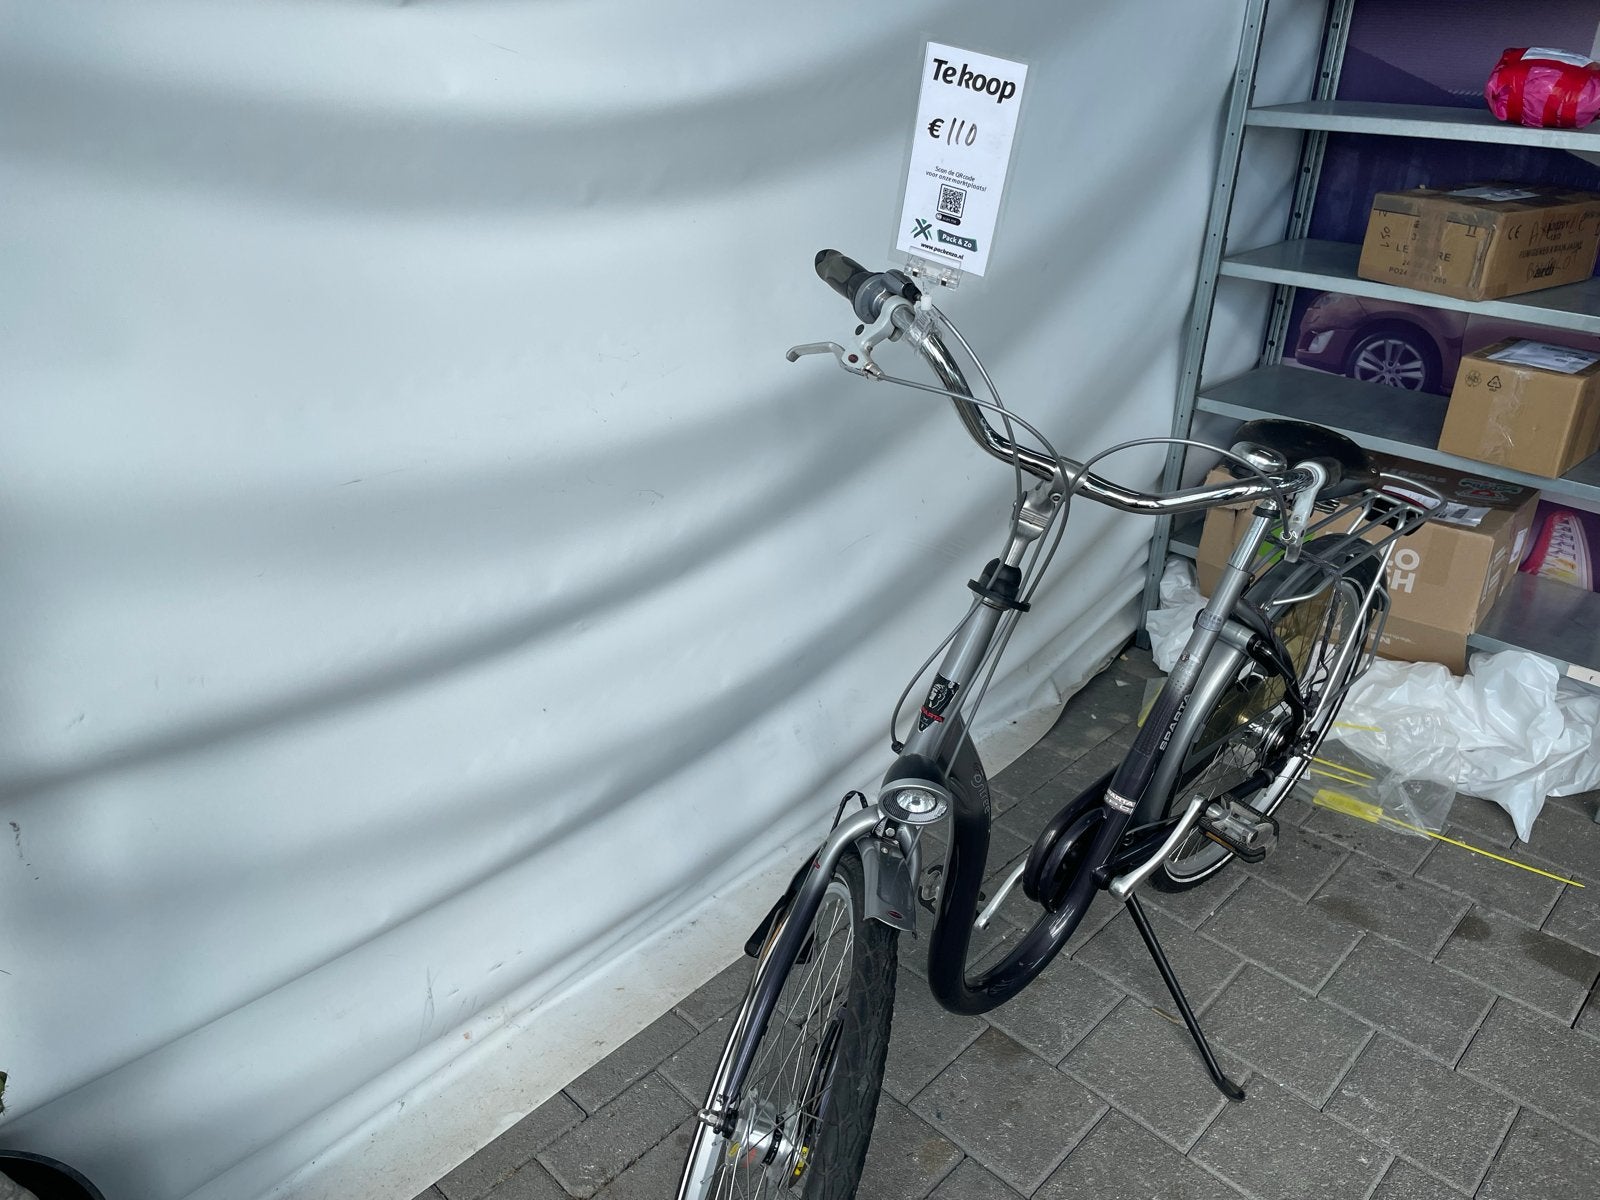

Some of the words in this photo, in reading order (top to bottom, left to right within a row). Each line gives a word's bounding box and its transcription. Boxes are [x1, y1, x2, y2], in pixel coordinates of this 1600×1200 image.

[957, 63, 1016, 104] koop
[943, 234, 957, 244] Pack
[963, 240, 973, 249] Zo
[1387, 548, 1420, 571] O
[1386, 567, 1416, 593] H
[1159, 693, 1192, 751] SPARTA
